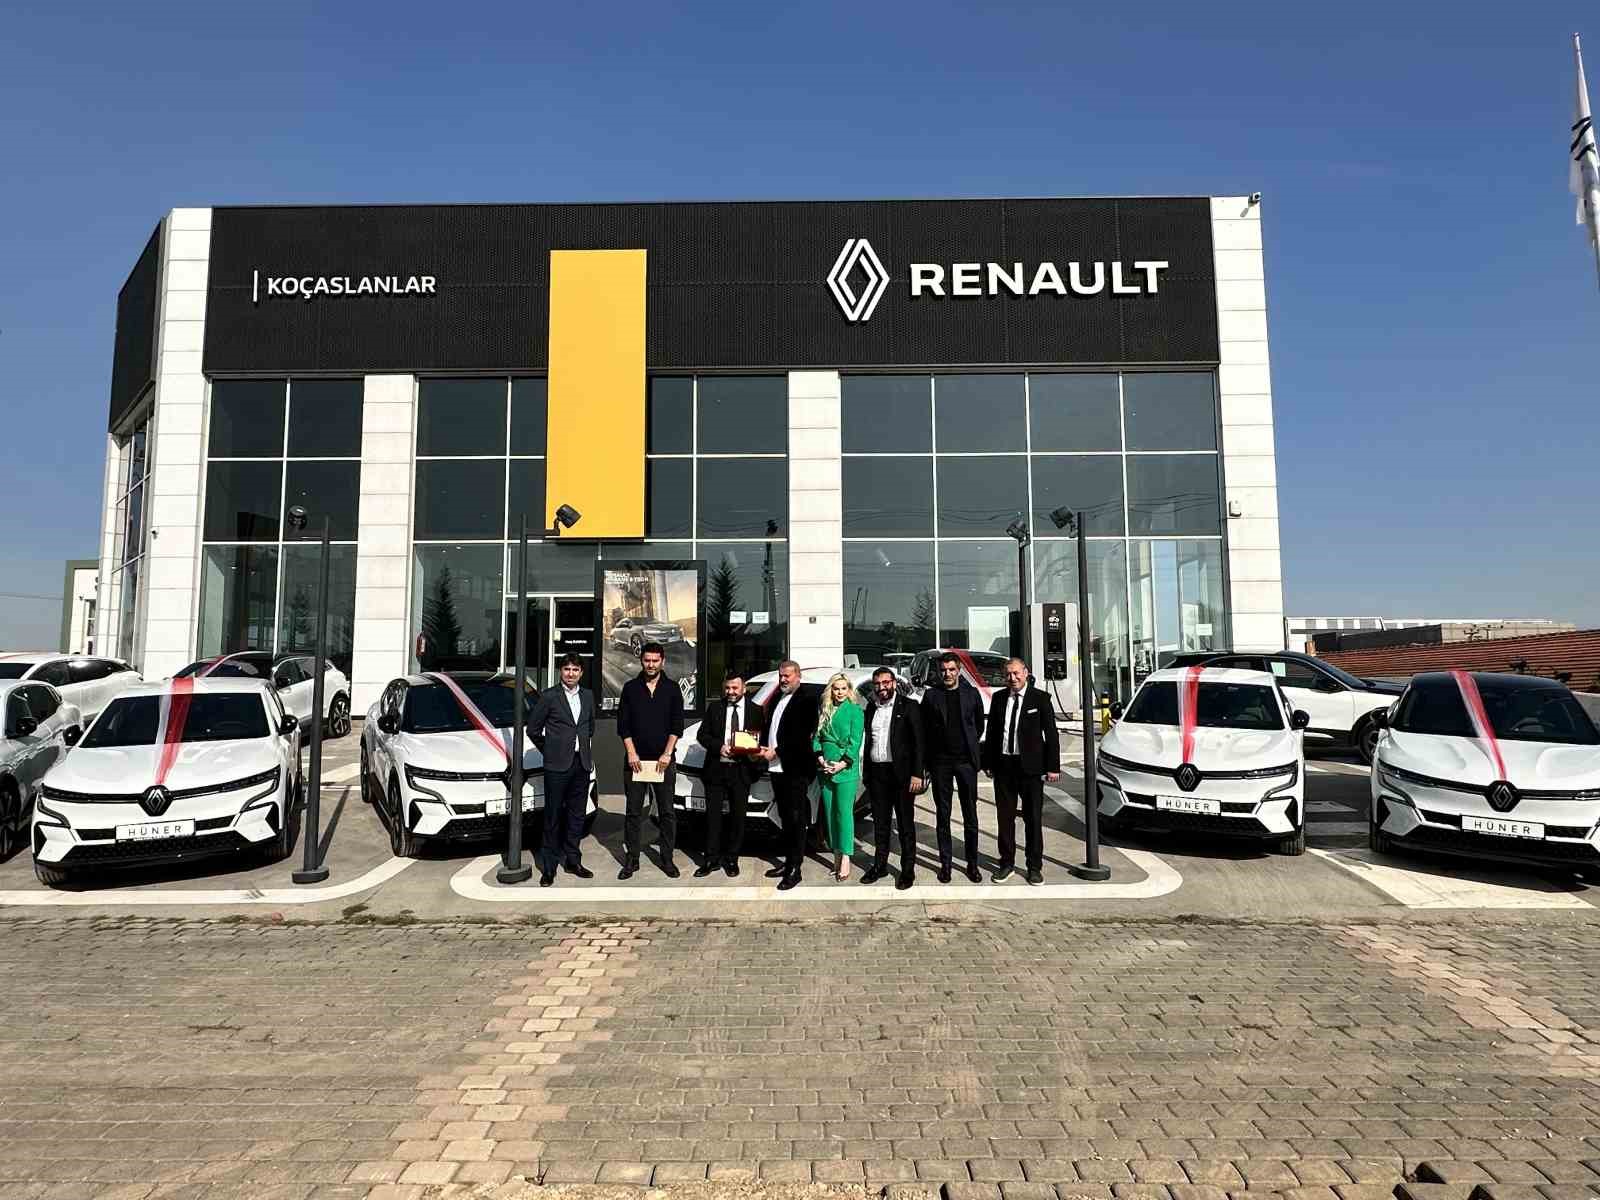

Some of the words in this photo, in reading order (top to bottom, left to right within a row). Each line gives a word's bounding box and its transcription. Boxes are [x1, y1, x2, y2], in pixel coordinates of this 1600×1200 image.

[910, 260, 1169, 296] RENAULT
[267, 276, 436, 299] KOÇASLANLAR
[495, 800, 536, 812] HÜER
[1165, 799, 1210, 812] HÜNER
[128, 824, 182, 837] HÜNER
[1474, 819, 1531, 835] HÜNER
